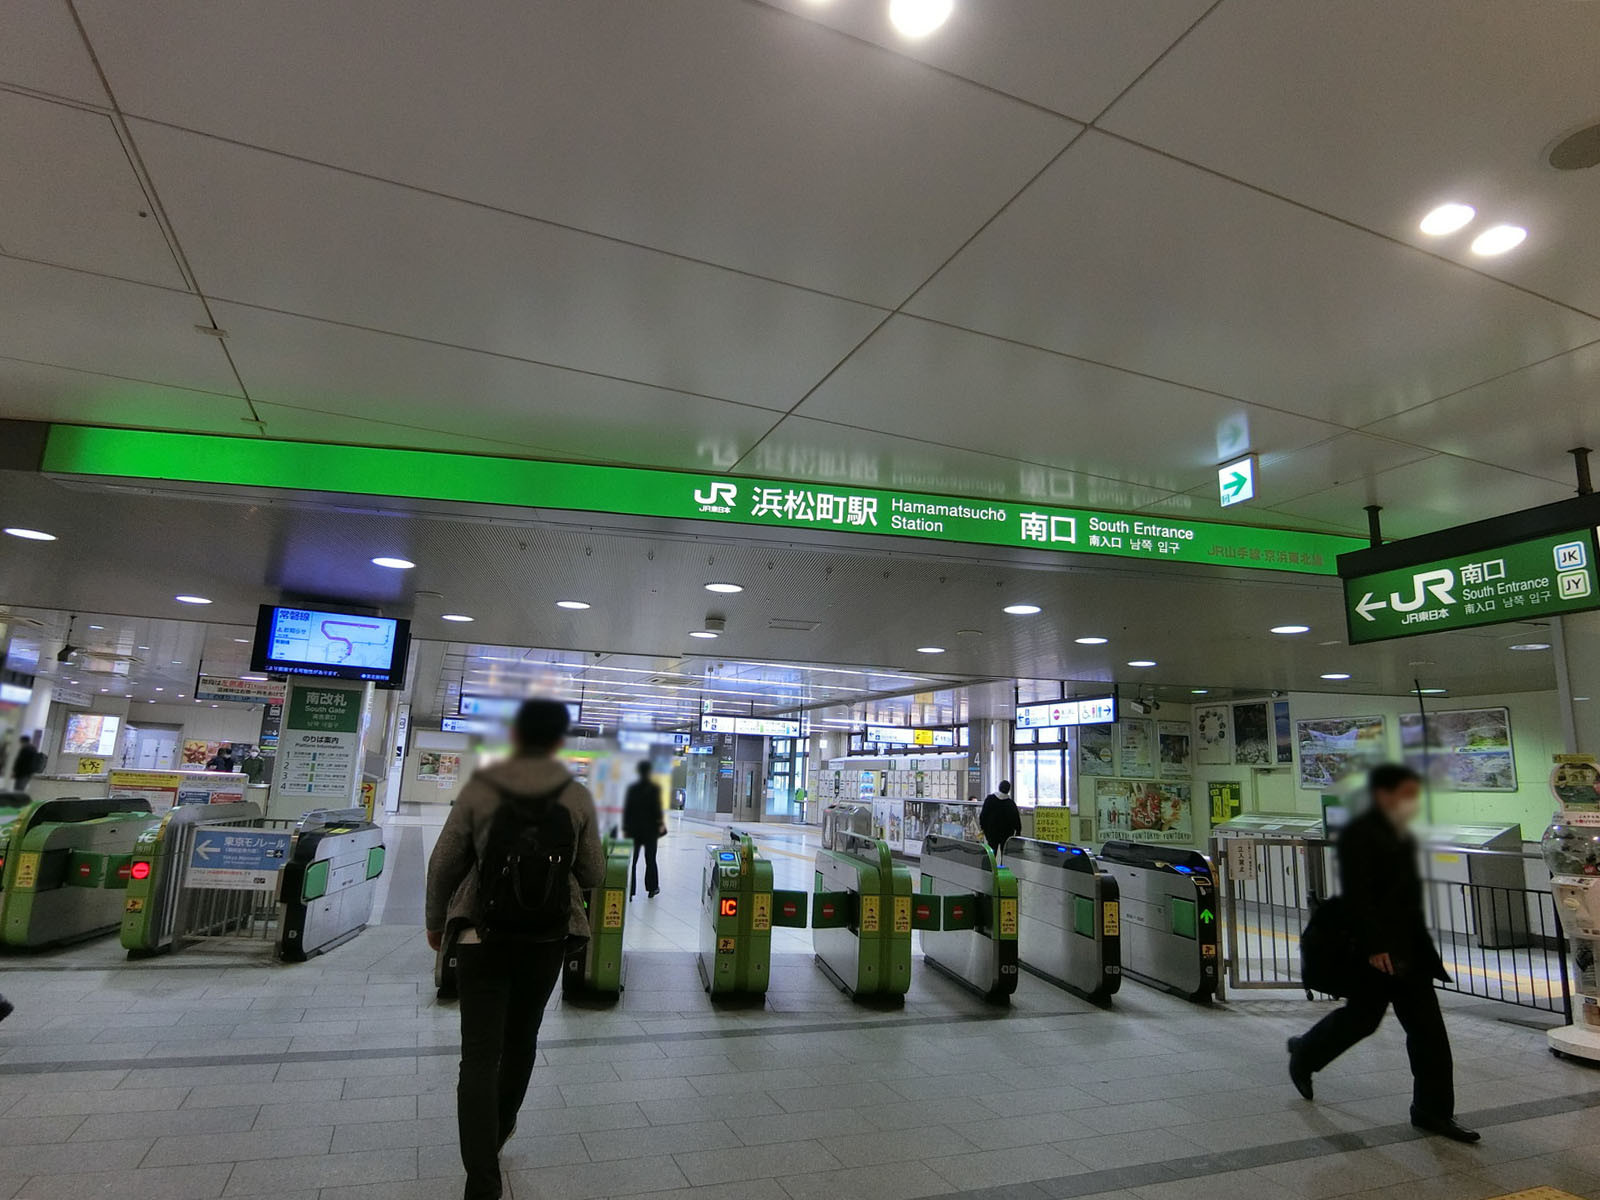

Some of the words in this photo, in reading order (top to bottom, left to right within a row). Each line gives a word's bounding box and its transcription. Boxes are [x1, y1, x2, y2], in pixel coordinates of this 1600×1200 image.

[694, 482, 737, 507] JR
[751, 487, 878, 527] 浜松町駅
[891, 498, 1006, 522] Hamamatsuchō
[891, 515, 943, 532] Station
[1019, 512, 1076, 544] 南口
[1089, 517, 1129, 533] South
[1134, 521, 1194, 540] Entrance
[1089, 534, 1122, 548] 南入口
[1130, 538, 1152, 551] 남쪽
[1158, 541, 1180, 554] 입구
[1561, 550, 1578, 563] JK
[1459, 559, 1506, 586] 南口
[1390, 569, 1457, 612] JR
[1462, 585, 1495, 601] South
[1497, 577, 1549, 594] Entrance
[1565, 578, 1581, 591] JY
[1464, 600, 1496, 615] 南入口
[1503, 595, 1525, 609] 남쪽
[1529, 591, 1552, 605] 입구
[1401, 608, 1450, 625] JR東日本
[306, 692, 347, 706] 南改札
[305, 705, 327, 713] South
[328, 706, 346, 714] Gate
[302, 736, 340, 744] のりば案内
[284, 762, 290, 770] 2
[974, 752, 981, 766] 4
[282, 772, 288, 780] 3
[223, 836, 286, 849] 東京モノレール
[721, 866, 739, 878] IC
[721, 899, 737, 915] IC
